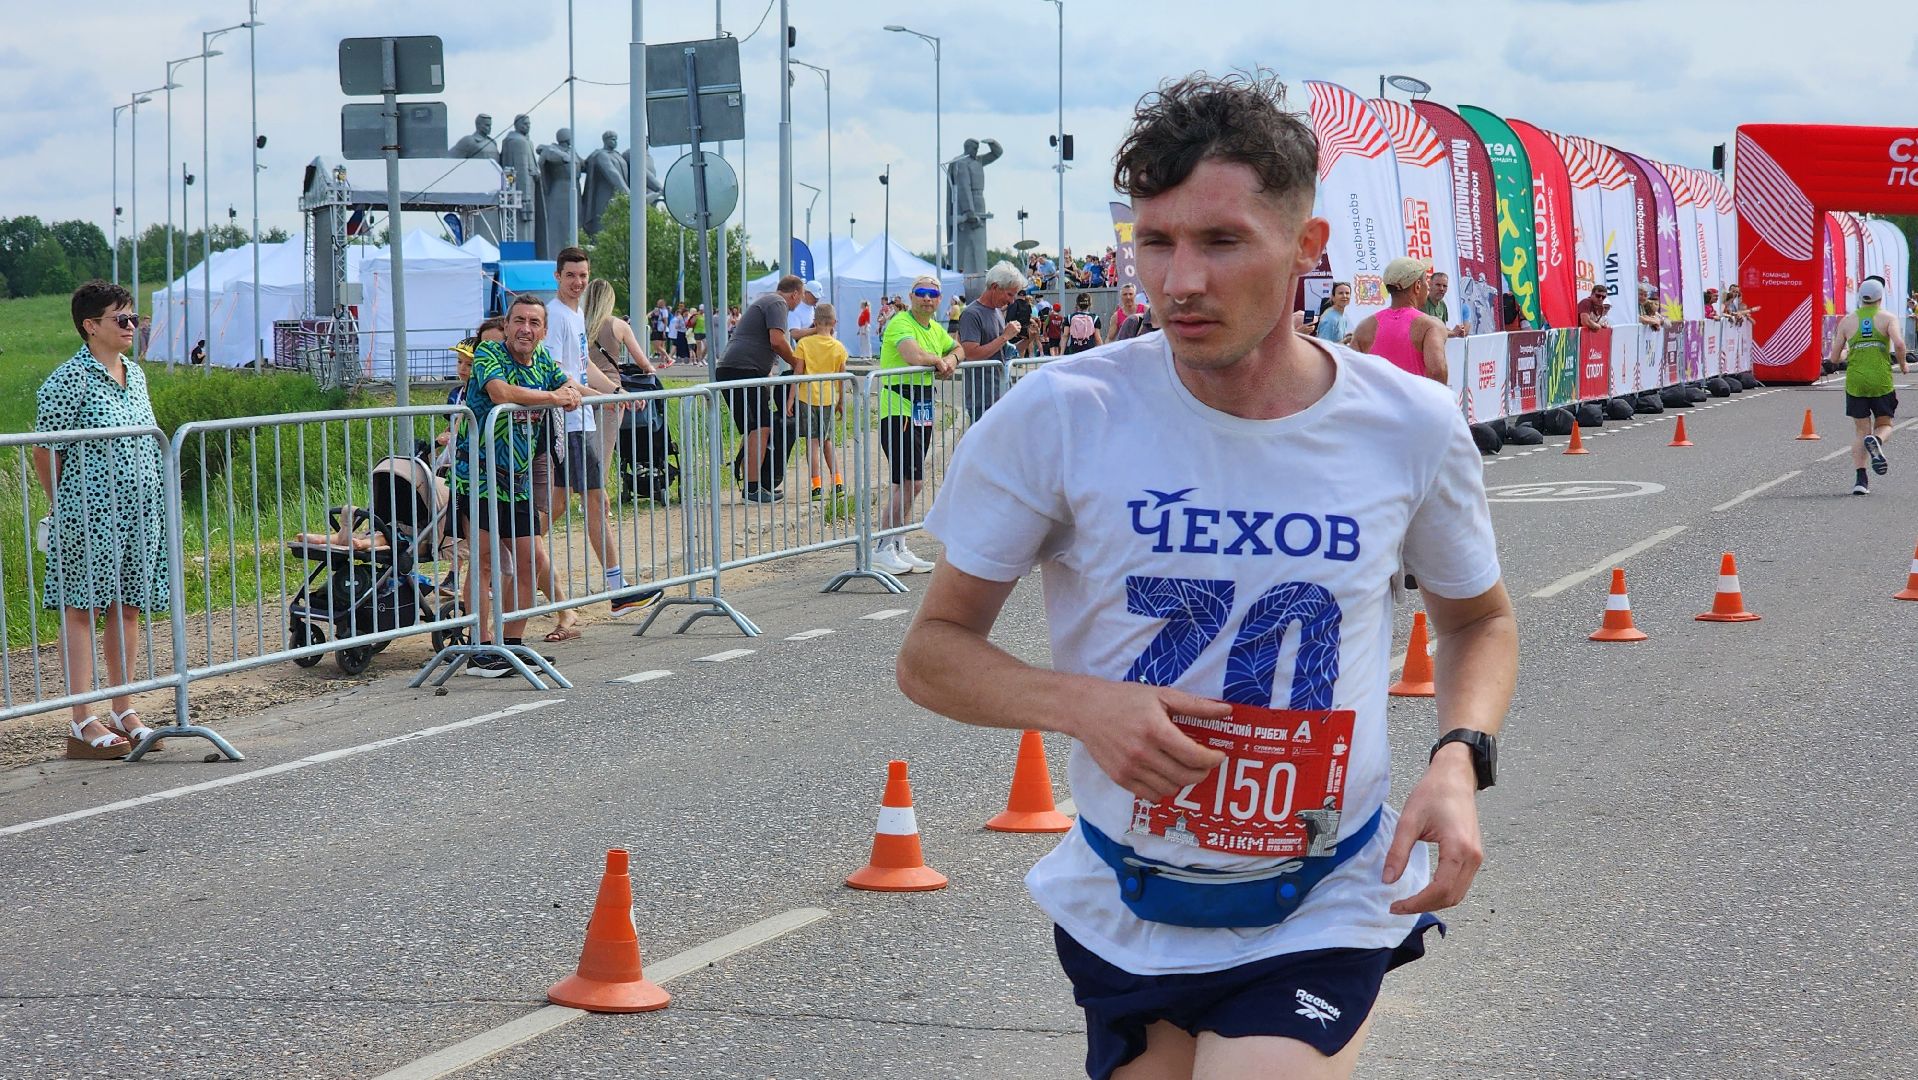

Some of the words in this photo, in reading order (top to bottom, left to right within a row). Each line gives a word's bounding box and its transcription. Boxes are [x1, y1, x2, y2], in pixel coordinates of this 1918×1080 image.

[1889, 138, 1918, 163] С
[1127, 498, 1361, 562] ЧЕХОВ
[1123, 575, 1343, 711] 70
[1254, 726, 1288, 741] РУБЕЖ
[1295, 988, 1341, 1019] Reebok
